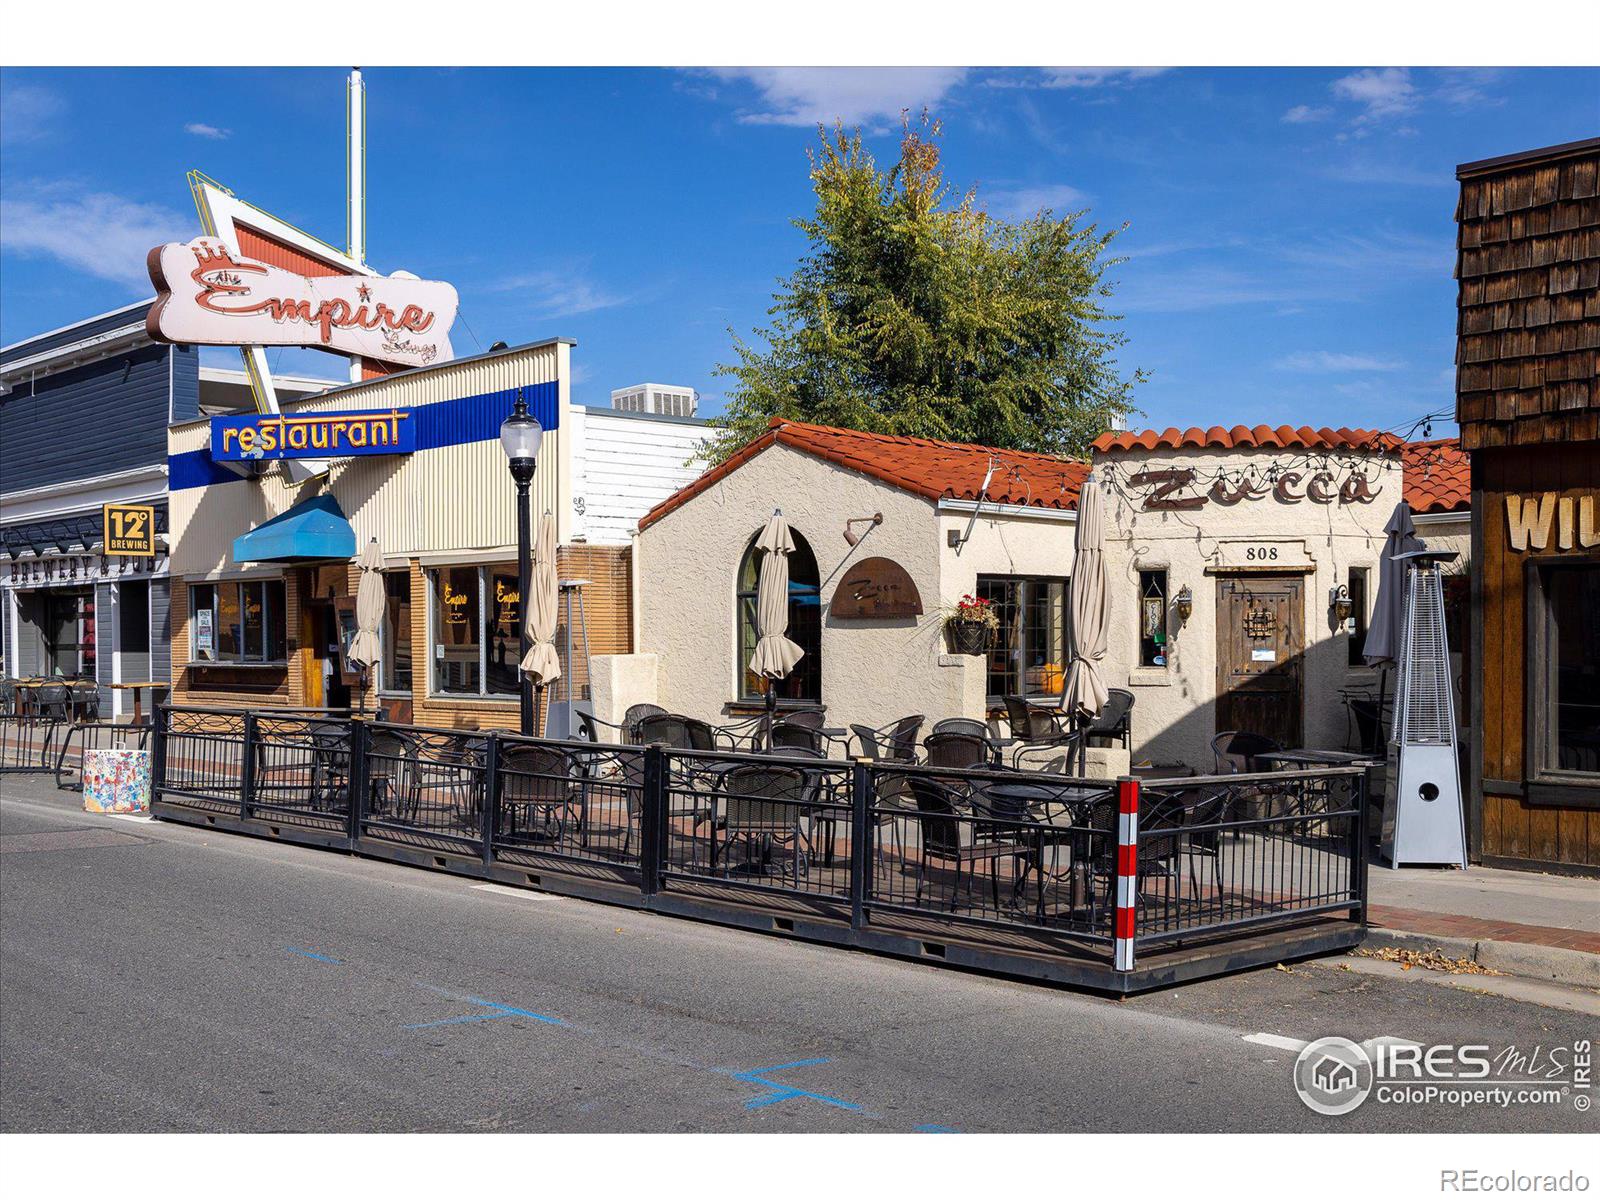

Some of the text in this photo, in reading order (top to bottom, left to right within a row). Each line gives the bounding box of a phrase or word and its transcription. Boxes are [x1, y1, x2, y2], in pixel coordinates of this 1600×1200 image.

[191, 241, 435, 343] Empire
[222, 409, 410, 454] restaurant
[1130, 469, 1383, 509] Zucca
[111, 540, 148, 550] BREWING
[1246, 547, 1279, 560] 808
[10, 555, 94, 584] BREWERY
